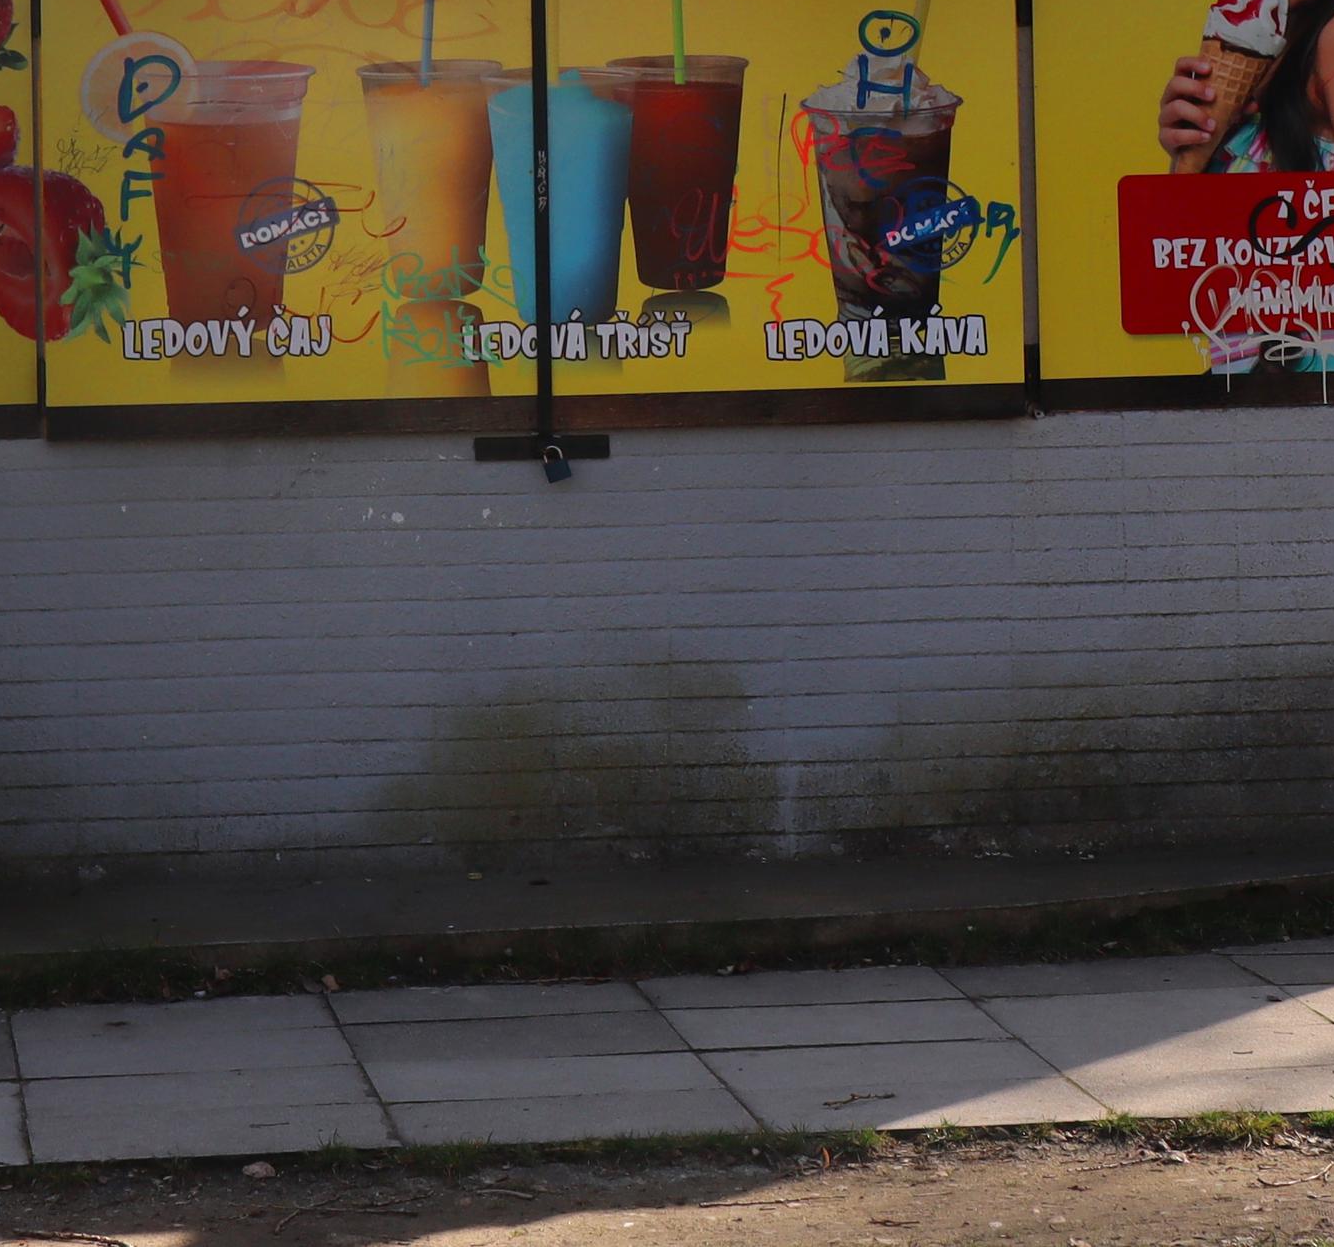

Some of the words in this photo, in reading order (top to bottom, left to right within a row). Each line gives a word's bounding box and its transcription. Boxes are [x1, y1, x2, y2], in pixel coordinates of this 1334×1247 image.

[239, 202, 331, 249] DOMÁCÍ
[287, 243, 328, 270] ALITA
[1152, 237, 1207, 269] BEZ
[122, 305, 255, 360] LEDOVÝ
[266, 304, 333, 358] ČAJ
[461, 309, 588, 362] LEDOVÁ
[595, 309, 692, 359] TŘÍŠŤ
[763, 304, 892, 362] LEDOVÁ
[899, 303, 988, 357] KÁVA
